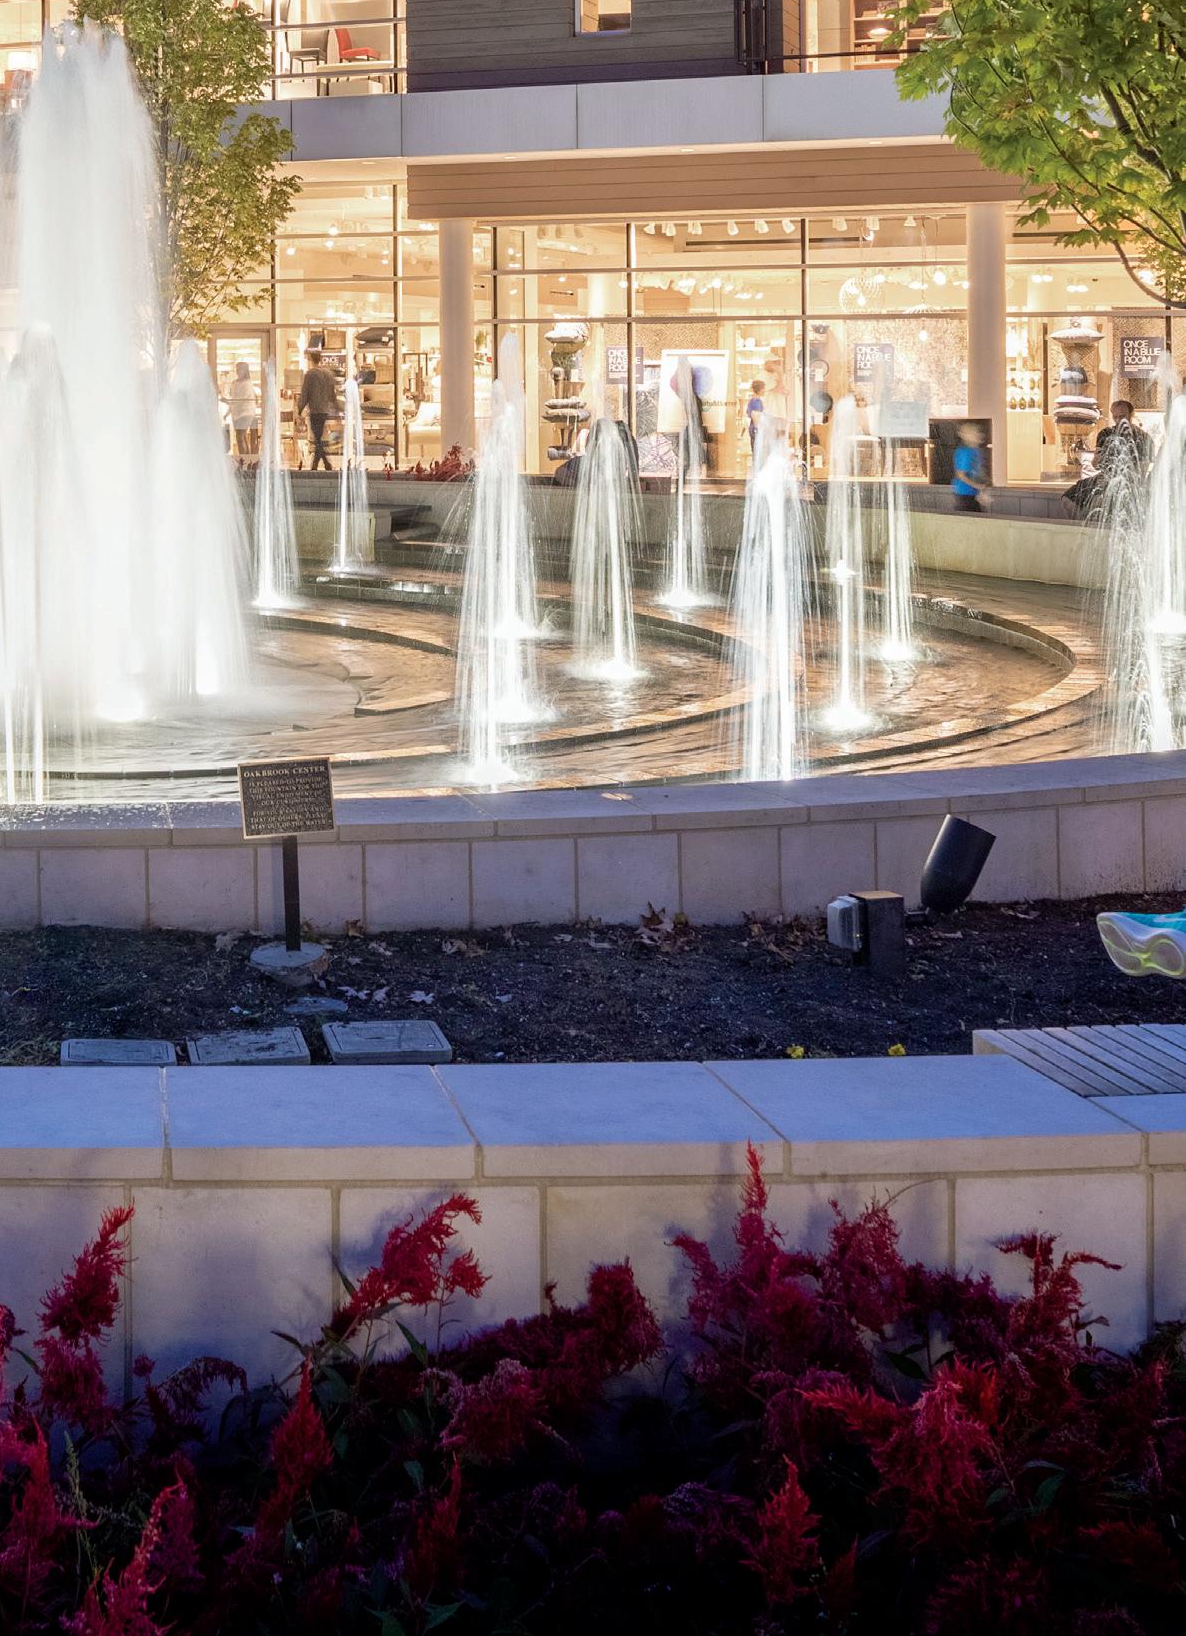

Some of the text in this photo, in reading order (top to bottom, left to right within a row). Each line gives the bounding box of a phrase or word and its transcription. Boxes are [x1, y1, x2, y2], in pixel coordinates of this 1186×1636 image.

[1123, 340, 1148, 348] ONCE
[1140, 348, 1162, 356] BLUE
[1124, 356, 1152, 364] ROOM
[243, 766, 325, 778] OAKBROOK CENTER
